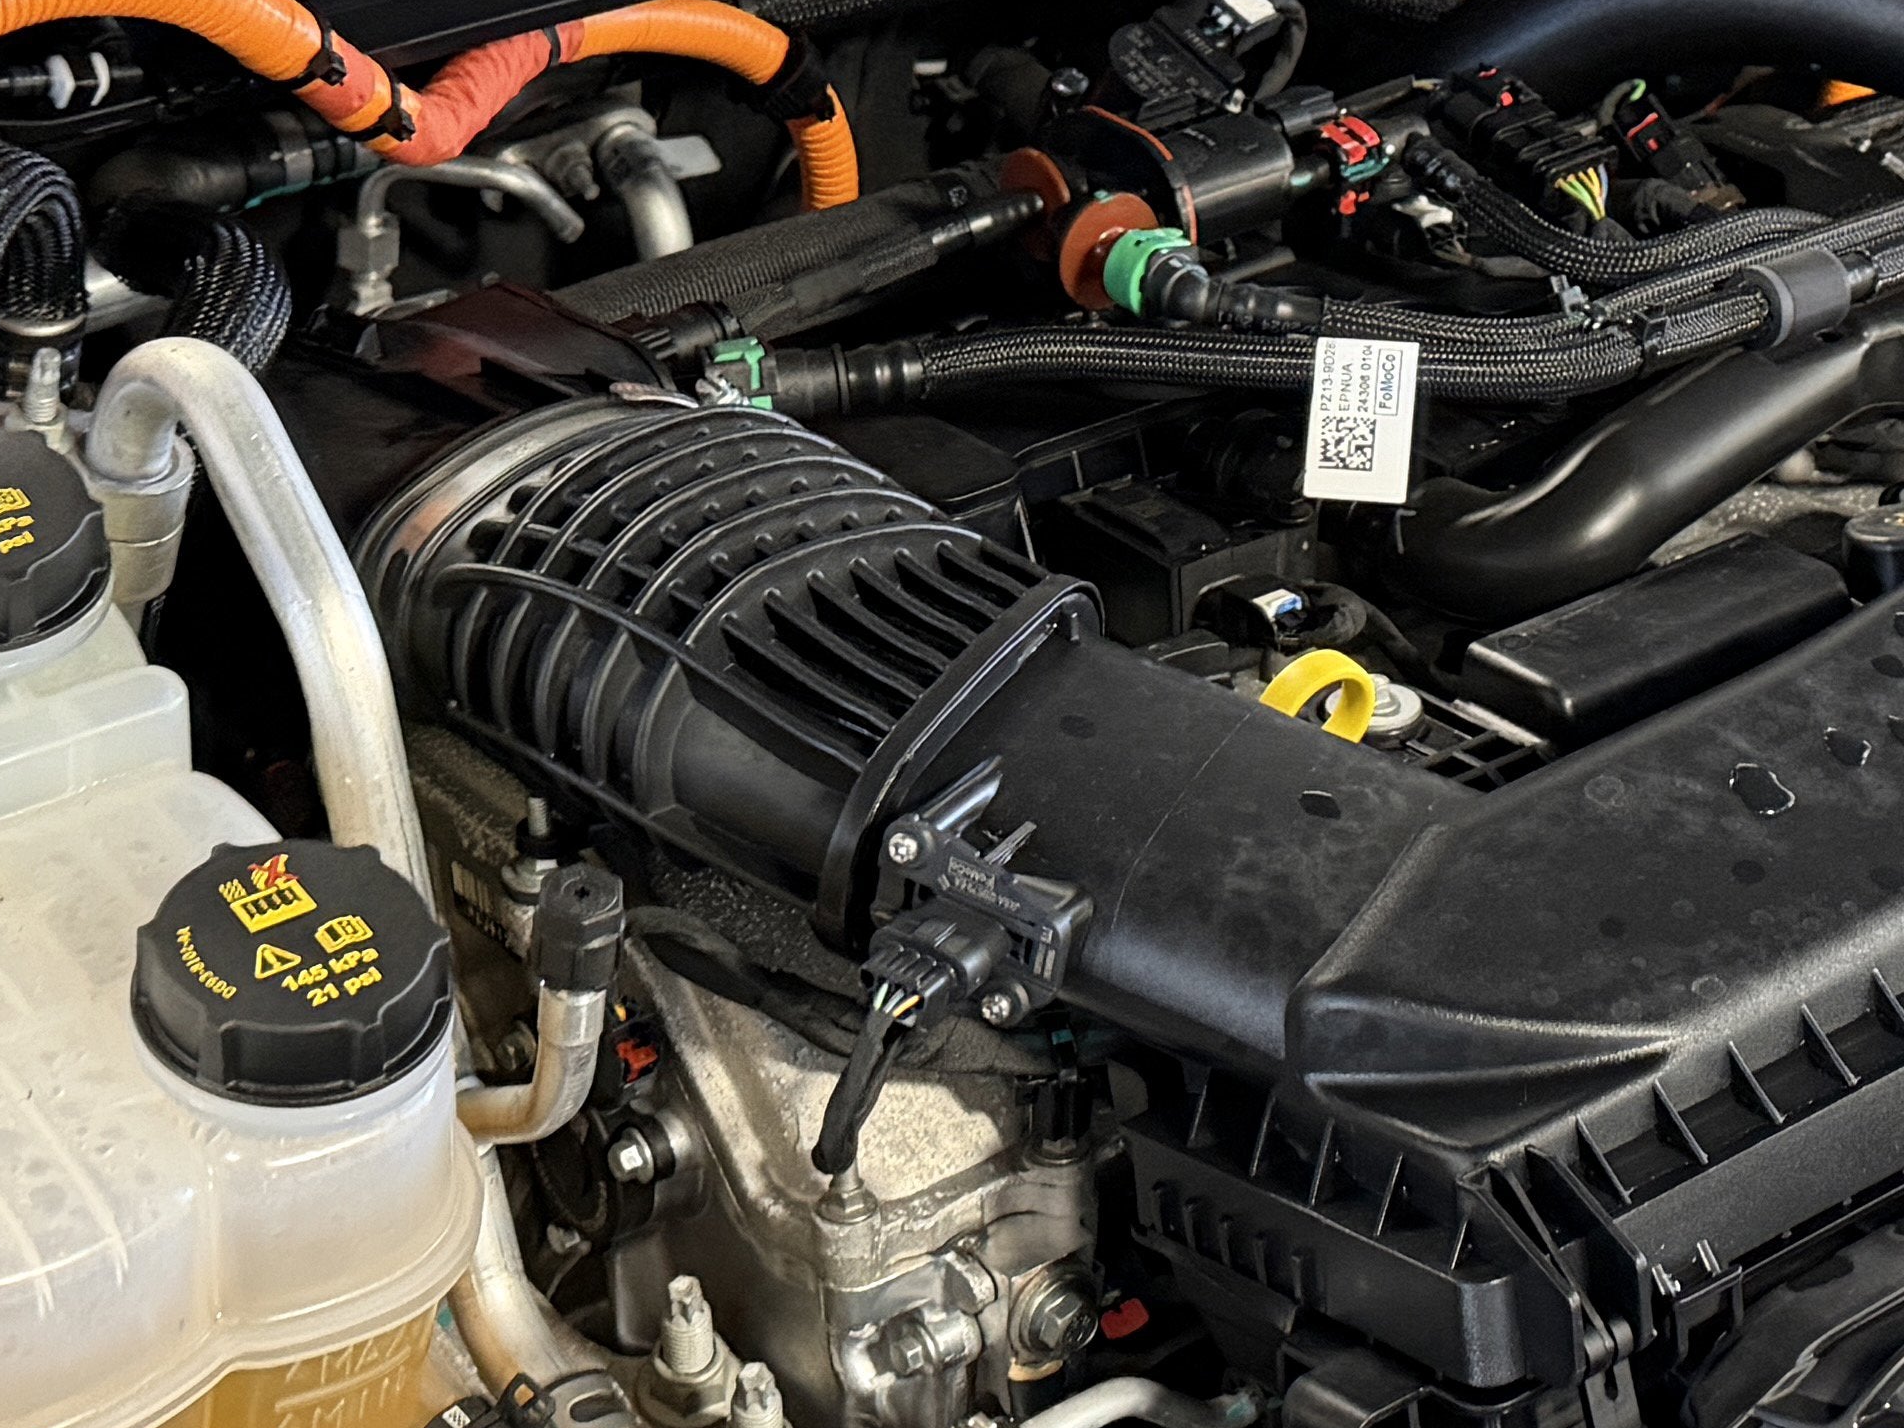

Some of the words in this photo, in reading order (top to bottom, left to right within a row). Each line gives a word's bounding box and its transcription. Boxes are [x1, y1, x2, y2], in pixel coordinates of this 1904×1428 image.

[1338, 362, 1354, 412] EPNUA
[1378, 353, 1396, 410] FoMoCo
[281, 963, 329, 992] 145
[328, 947, 380, 975] kPa
[307, 982, 341, 1008] 21
[343, 966, 383, 996] psi
